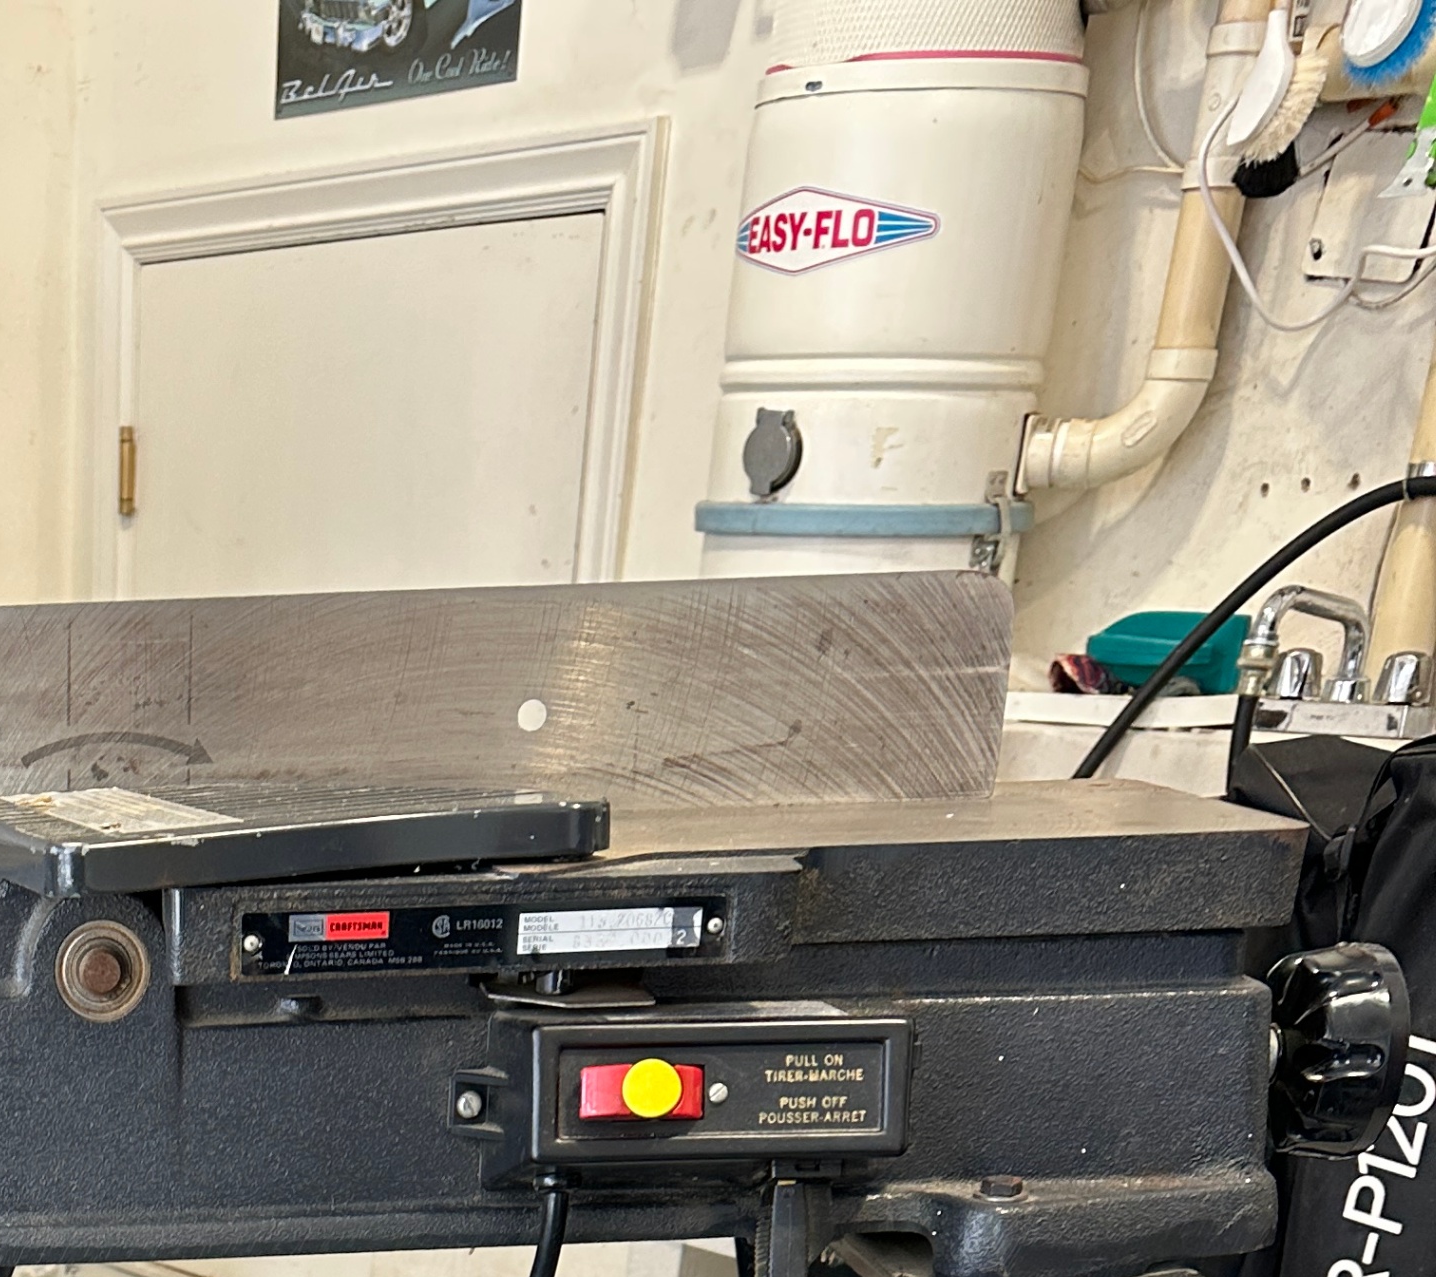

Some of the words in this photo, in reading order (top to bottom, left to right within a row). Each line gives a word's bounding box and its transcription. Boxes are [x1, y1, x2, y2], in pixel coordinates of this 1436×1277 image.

[469, 47, 511, 75] Ride!
[748, 208, 876, 254] EASY-FLO
[456, 918, 504, 931] LR16012
[523, 915, 554, 923] MODEL
[330, 922, 383, 932] CRAFTSMAN
[368, 941, 386, 950] PAR
[522, 935, 554, 944] SERIAL
[359, 948, 395, 958] LIMITED
[347, 956, 384, 966] CANADA
[785, 1053, 818, 1067] PULL
[824, 1053, 844, 1067] ON
[764, 1068, 864, 1083] TIRER-MARCHE
[779, 1096, 817, 1109] PUSH
[821, 1095, 848, 1109] OFF
[758, 1110, 866, 1124] POUSSER-ARRET
